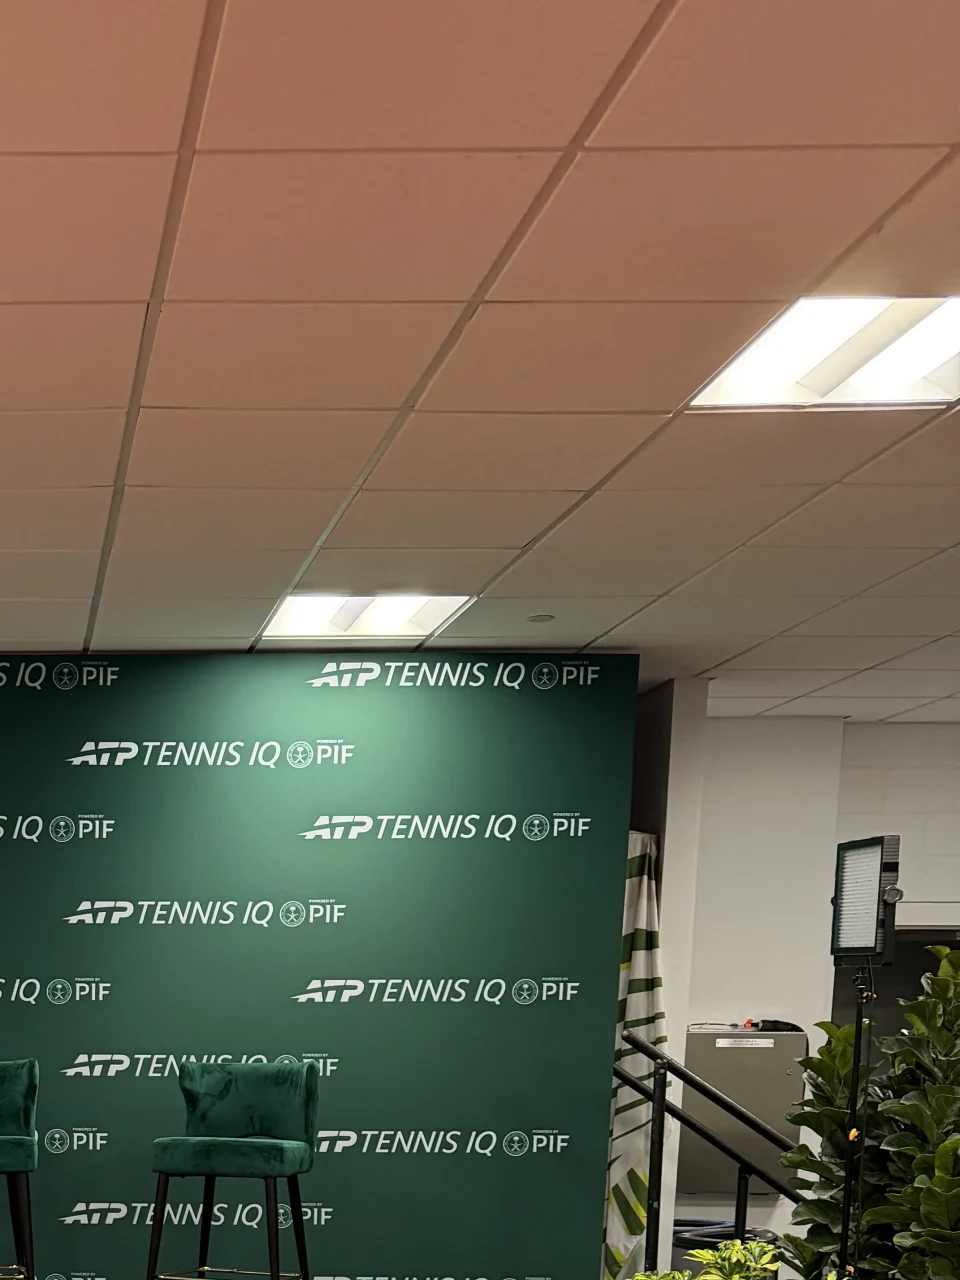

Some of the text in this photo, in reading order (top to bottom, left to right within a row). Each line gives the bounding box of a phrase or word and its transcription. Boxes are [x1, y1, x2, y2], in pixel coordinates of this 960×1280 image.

[15, 662, 47, 690] IQ
[82, 666, 120, 686] PIF
[304, 662, 381, 688] ATP
[384, 662, 489, 687] TENNIS
[493, 662, 526, 690] IQ
[562, 666, 601, 686] PIF
[63, 741, 139, 766] ATP
[142, 741, 245, 766] TENNIS
[248, 741, 281, 769] IQ
[316, 744, 355, 765] PIF
[12, 815, 44, 843] IQ
[78, 819, 116, 839] PIF
[296, 815, 374, 840] ATP
[377, 814, 481, 839] TENNIS
[484, 814, 517, 842] IQ
[553, 818, 592, 837] PIF
[60, 900, 135, 924] ATP
[137, 900, 238, 925] TENNIS
[242, 900, 274, 928] IQ
[308, 904, 347, 924] PIF
[10, 978, 41, 1005] IQ
[75, 982, 112, 1001] PIF
[288, 979, 365, 1003] ATP
[368, 978, 470, 1003] TENNIS
[474, 978, 506, 1005] IQ
[541, 982, 580, 1001] PIF
[59, 1053, 131, 1077] ATP
[302, 1058, 340, 1077] IF
[72, 1132, 109, 1151] PIF
[314, 1130, 358, 1153] TP
[360, 1130, 462, 1154] TENNIS
[465, 1130, 498, 1157] IQ
[532, 1134, 570, 1153] PIF
[56, 1202, 128, 1225] ATP
[131, 1202, 229, 1226] TENNS
[232, 1203, 263, 1229] IQ
